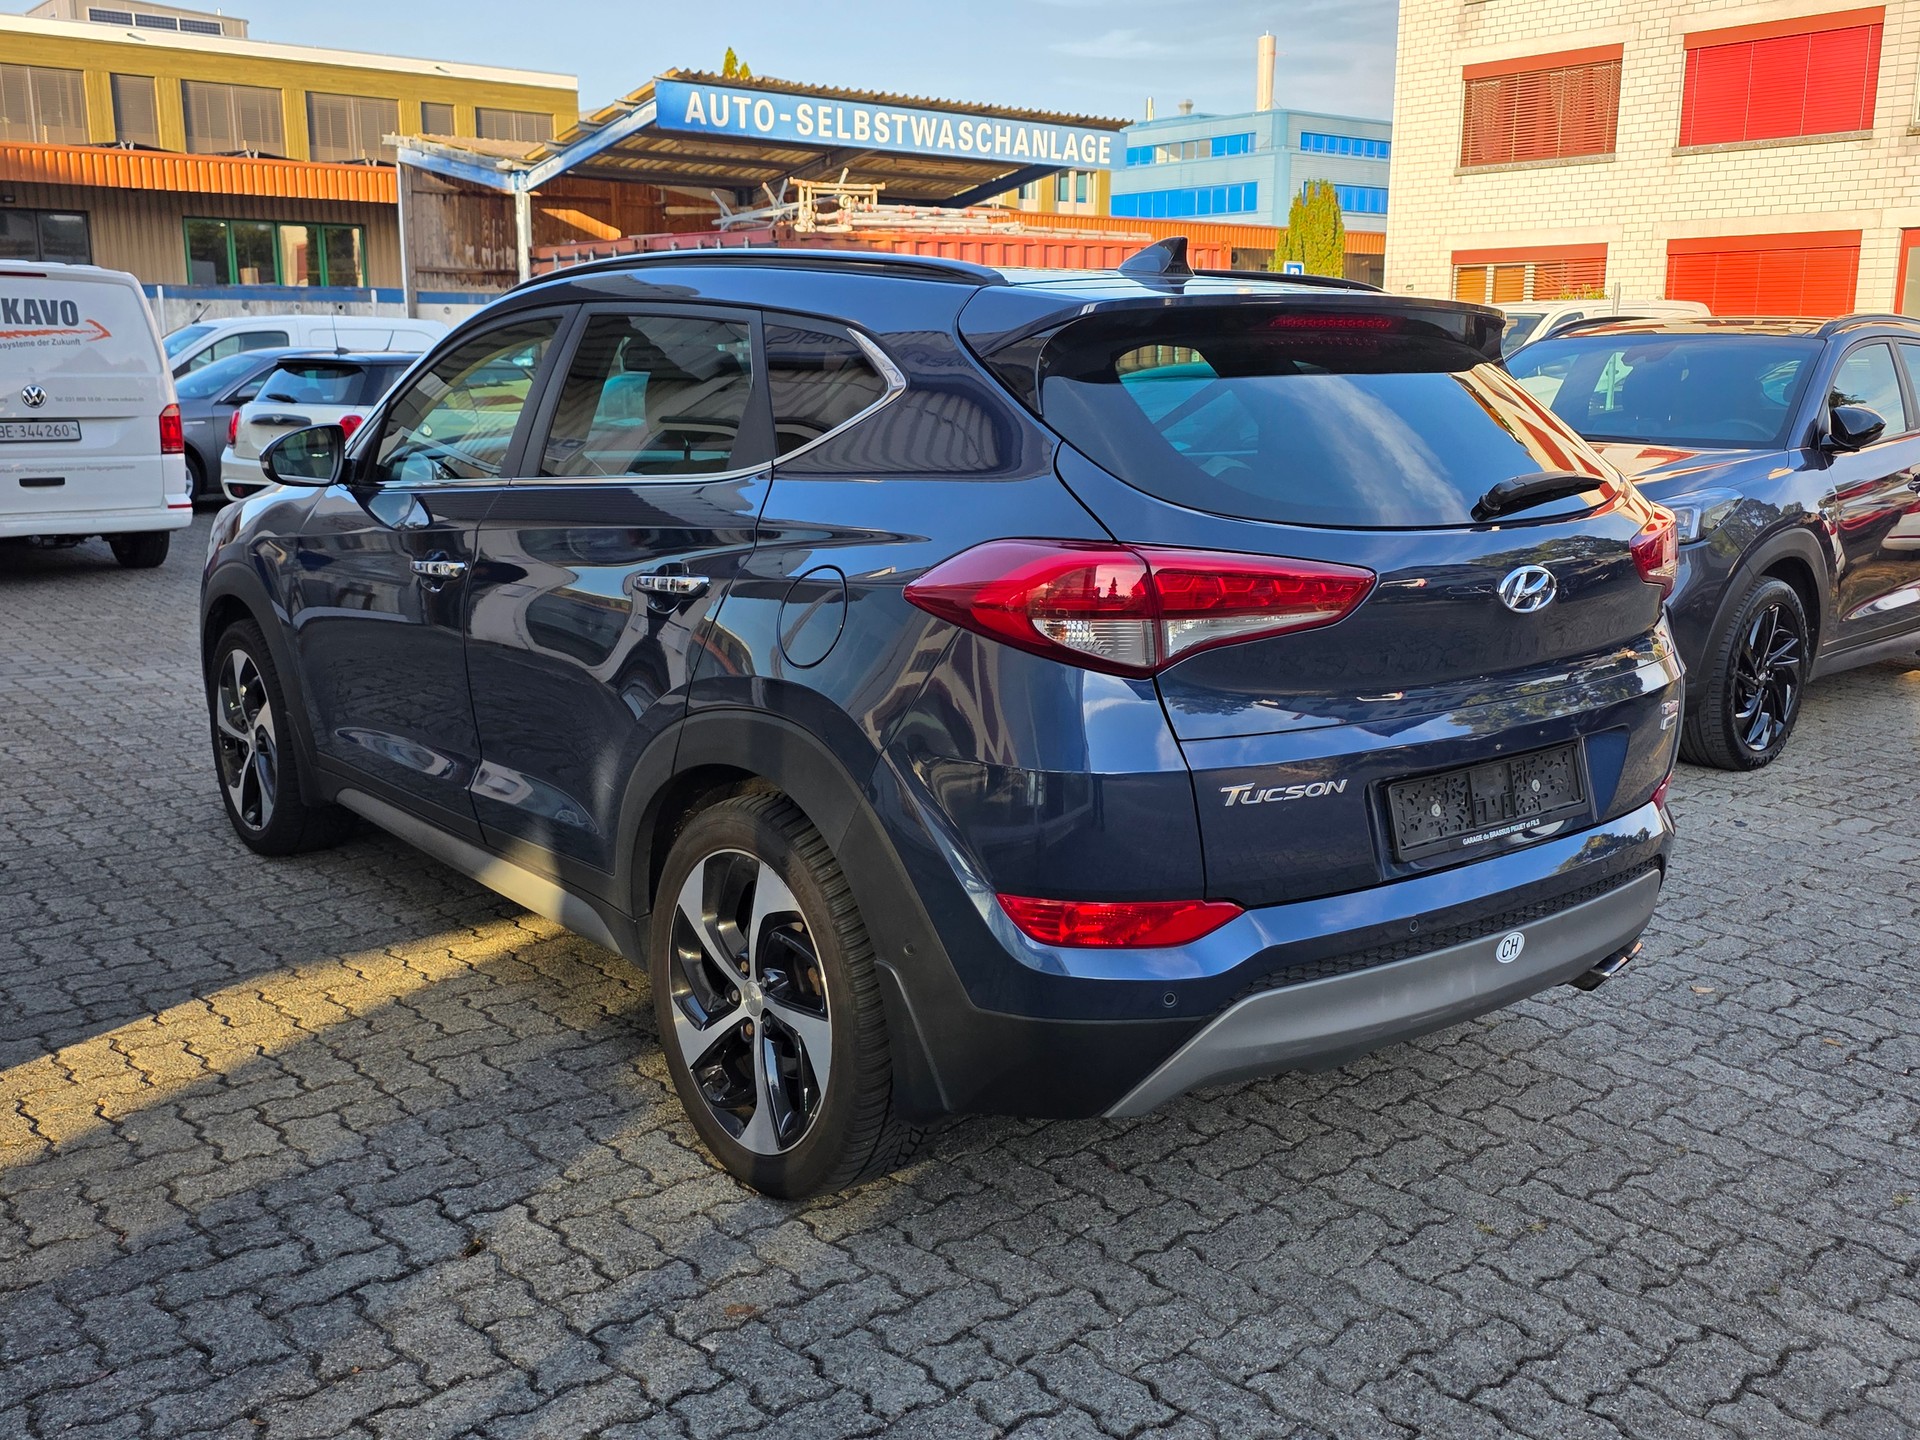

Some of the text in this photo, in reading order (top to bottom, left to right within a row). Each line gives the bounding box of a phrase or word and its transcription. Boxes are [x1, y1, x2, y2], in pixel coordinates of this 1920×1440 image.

[685, 91, 1111, 164] AUTO-SELBSTWASCHANLAGE
[0, 297, 79, 327] KAVO
[51, 338, 81, 346] Zukunft
[1462, 834, 1483, 845] GARAGE
[1489, 827, 1510, 838] BRASSUS
[1510, 822, 1526, 833] PIGUET
[1530, 818, 1540, 827] FILS
[1502, 937, 1520, 958] CH
